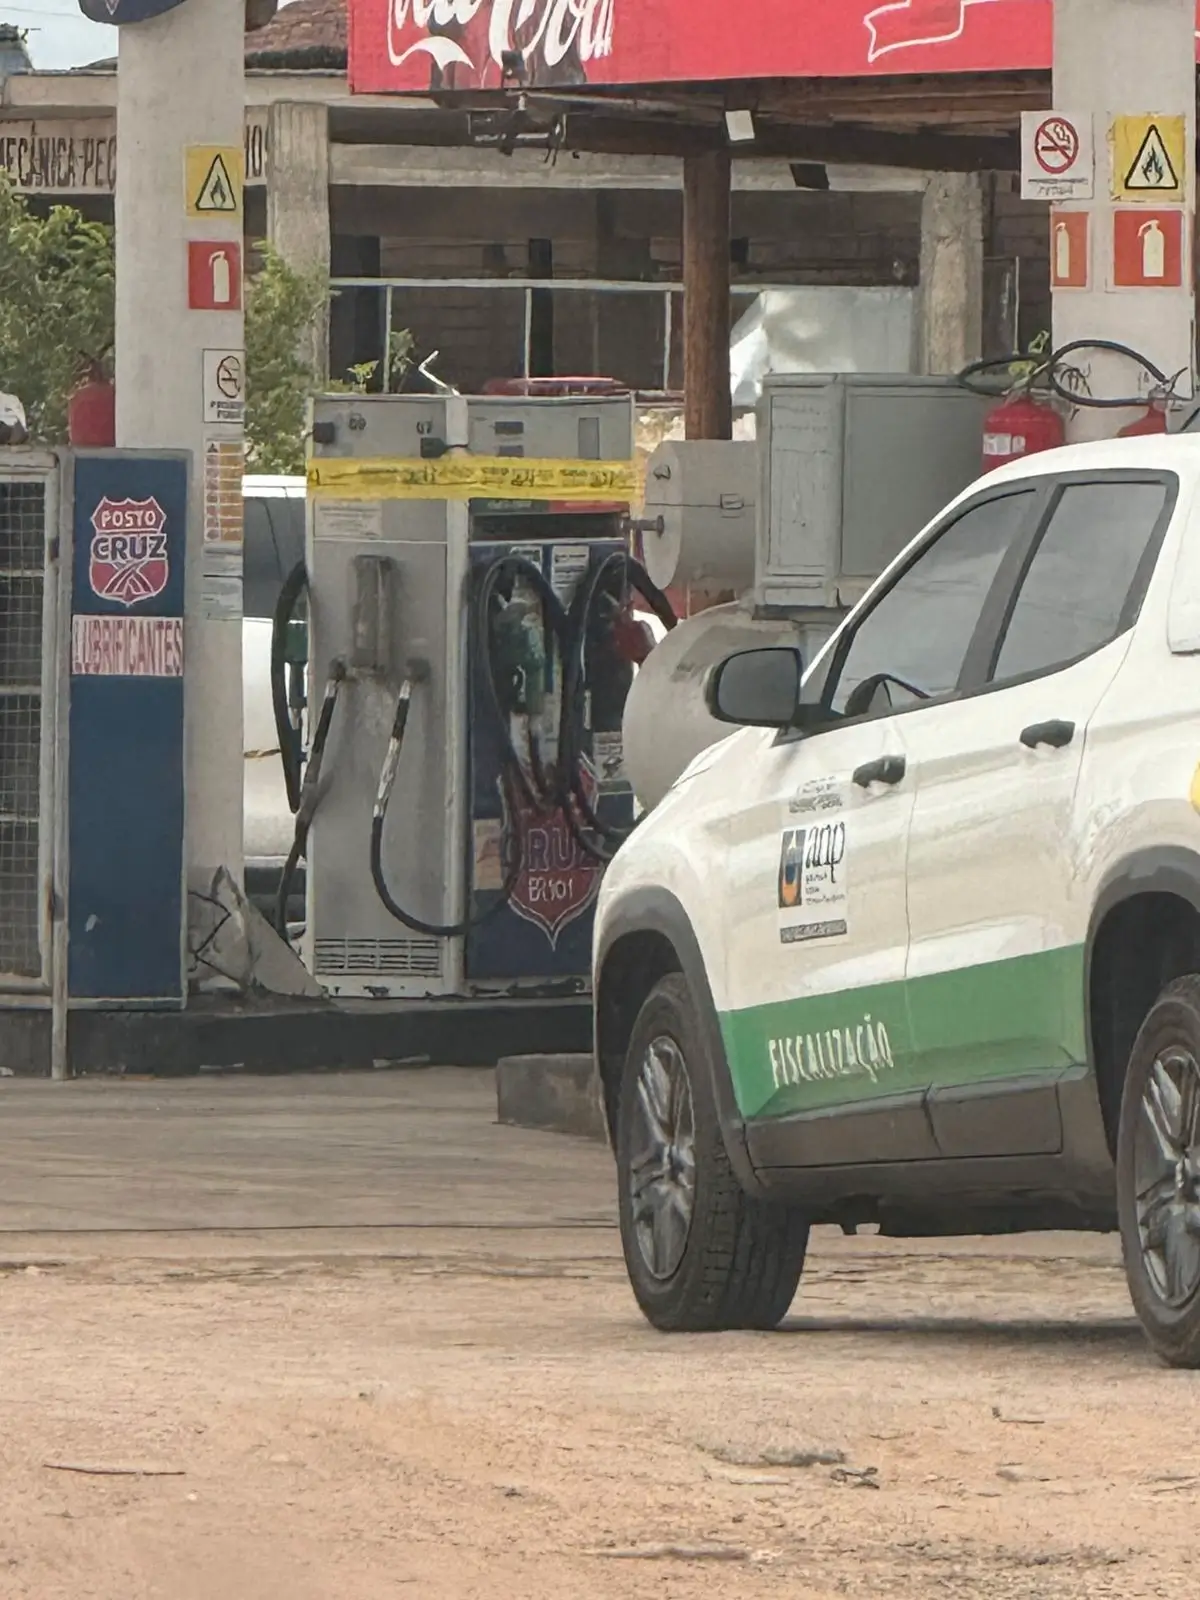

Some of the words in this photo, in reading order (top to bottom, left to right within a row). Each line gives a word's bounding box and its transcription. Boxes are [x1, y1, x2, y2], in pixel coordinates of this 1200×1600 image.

[101, 510, 156, 527] POSTO
[92, 533, 168, 562] CRUZ
[74, 620, 183, 675] LUBRIFICANTES
[806, 821, 845, 884] anp
[768, 1012, 894, 1089] FISCALIZAÇÃO
